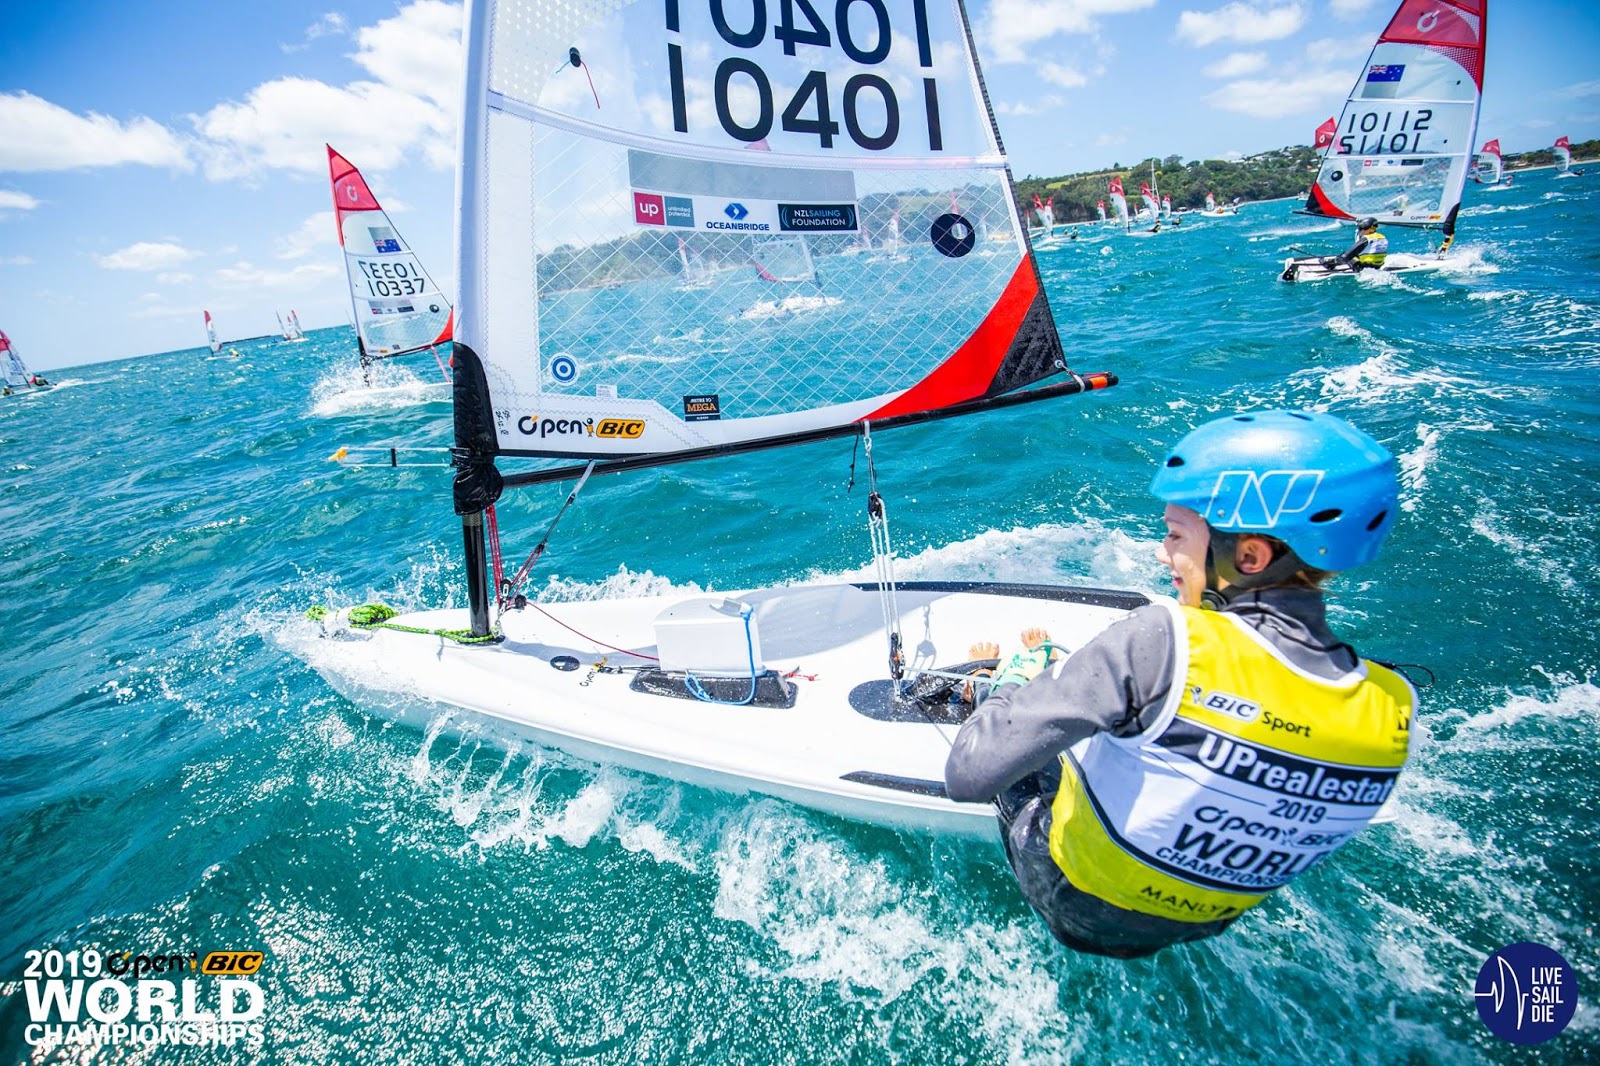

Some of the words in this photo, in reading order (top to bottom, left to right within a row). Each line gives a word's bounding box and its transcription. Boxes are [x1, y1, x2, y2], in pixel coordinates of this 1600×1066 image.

[667, 42, 943, 151] 10401
[1348, 109, 1433, 134] 10112
[639, 202, 659, 217] up
[706, 221, 770, 231] OCEANBRIDGE
[792, 218, 846, 227] FOUNDATION
[367, 278, 425, 297] 10337
[686, 402, 718, 412] MEGA
[1263, 711, 1312, 738] Sport
[1269, 798, 1327, 825] 2019
